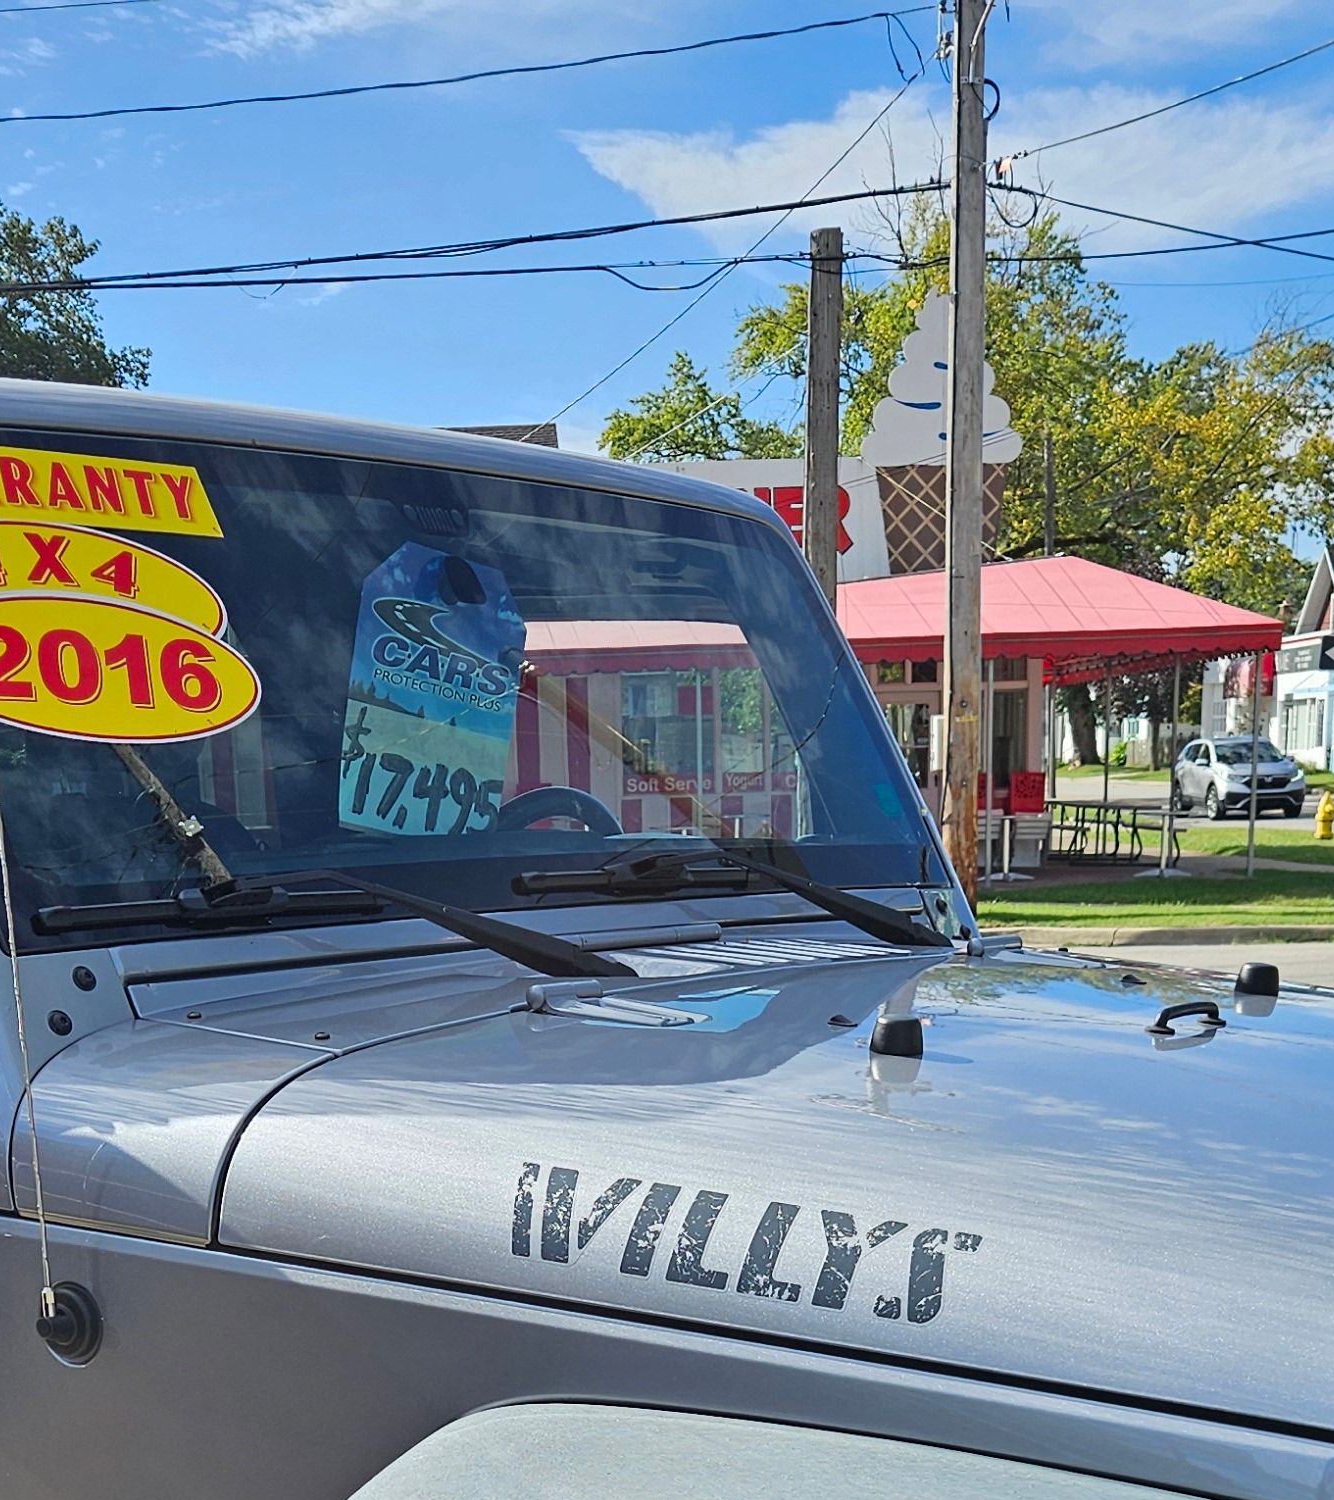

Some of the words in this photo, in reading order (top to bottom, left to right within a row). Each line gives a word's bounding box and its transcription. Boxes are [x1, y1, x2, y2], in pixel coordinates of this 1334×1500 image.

[373, 669, 466, 703] PROTECTION
[469, 693, 501, 713] PLUS
[627, 778, 659, 793] Soft
[665, 776, 712, 792] Serve
[725, 773, 763, 792] Yogurt
[510, 1161, 983, 1325] WILLYS
